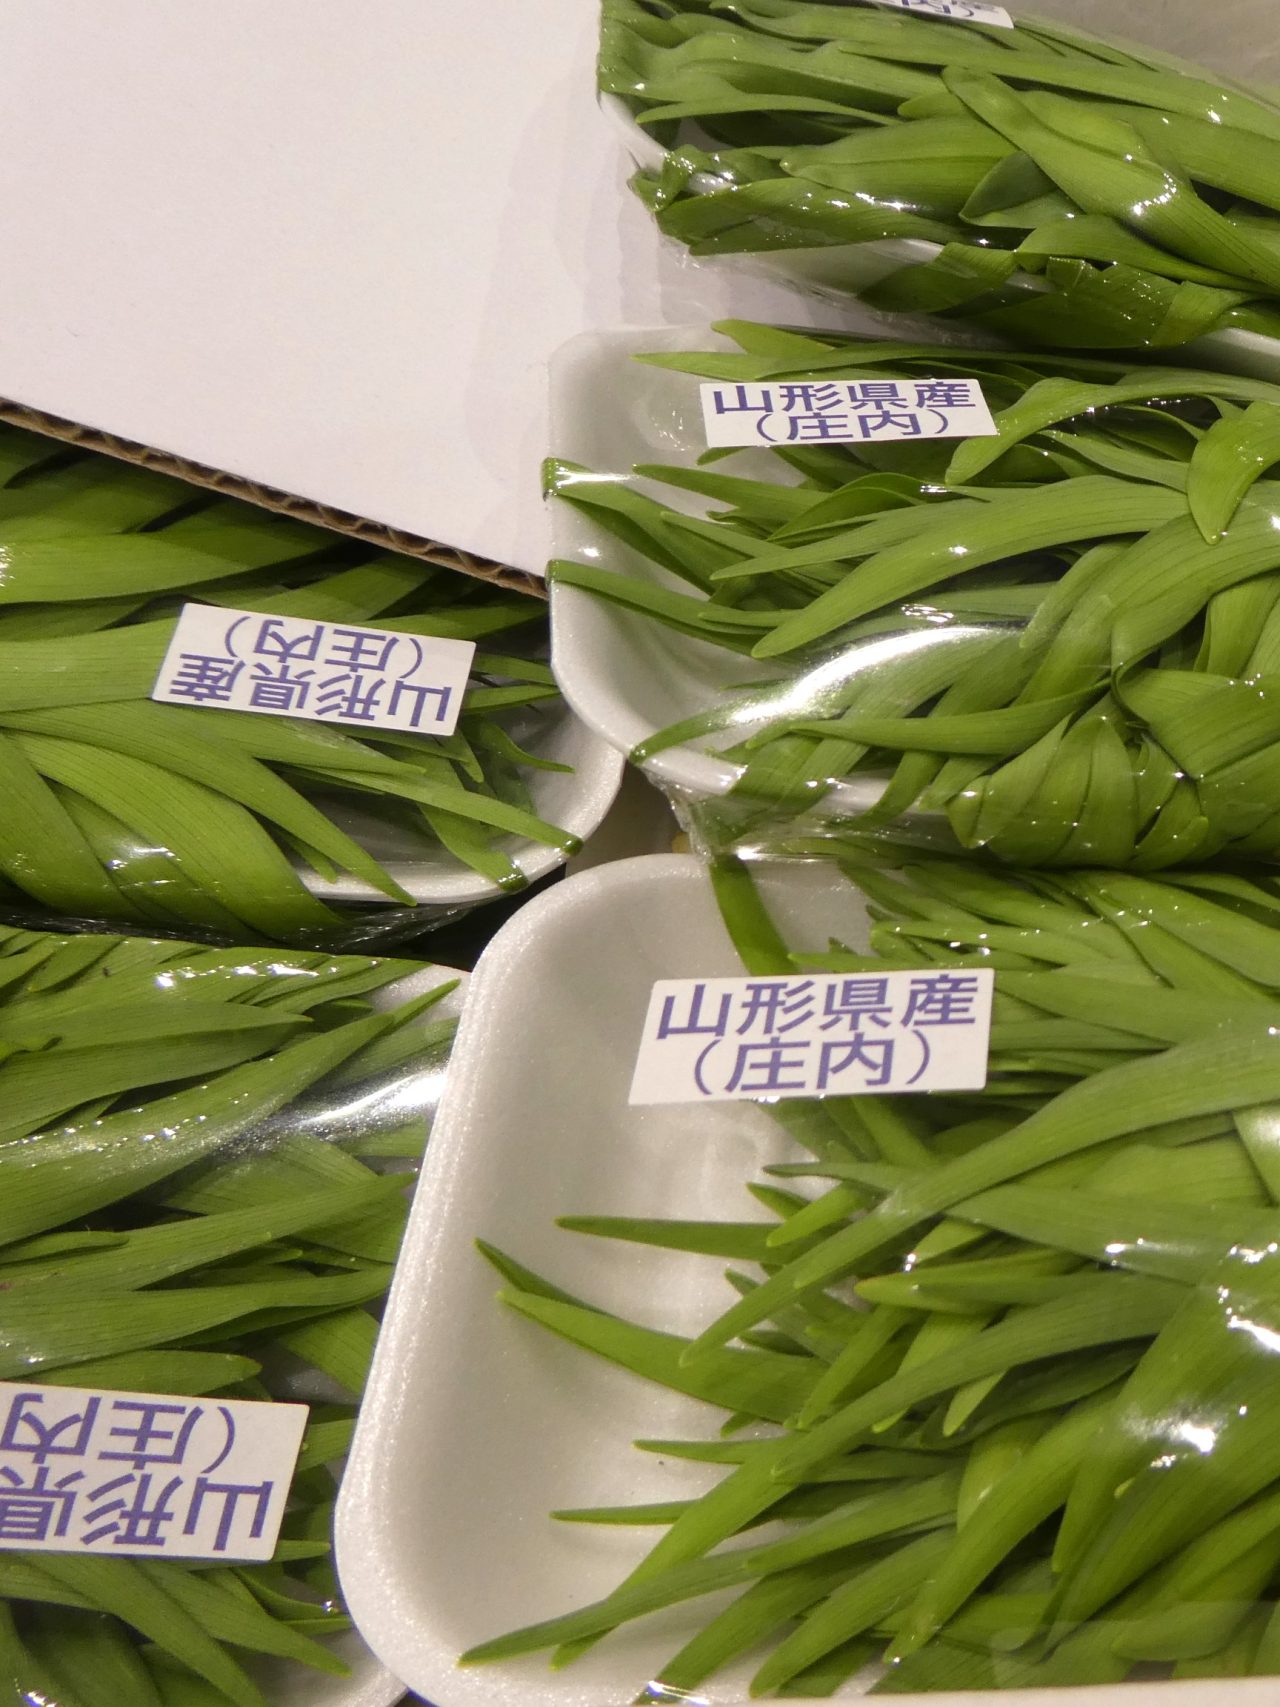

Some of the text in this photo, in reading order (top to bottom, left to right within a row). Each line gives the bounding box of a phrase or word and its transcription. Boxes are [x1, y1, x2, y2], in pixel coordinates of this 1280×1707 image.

[713, 380, 976, 414] 山形県産
[756, 408, 949, 442] （庄内）
[224, 615, 423, 679] （庄内）
[168, 653, 452, 727] 山形県産
[656, 973, 979, 1040] 山形県産
[693, 1029, 931, 1096] （庄内）
[0, 1466, 275, 1551] 山形県
